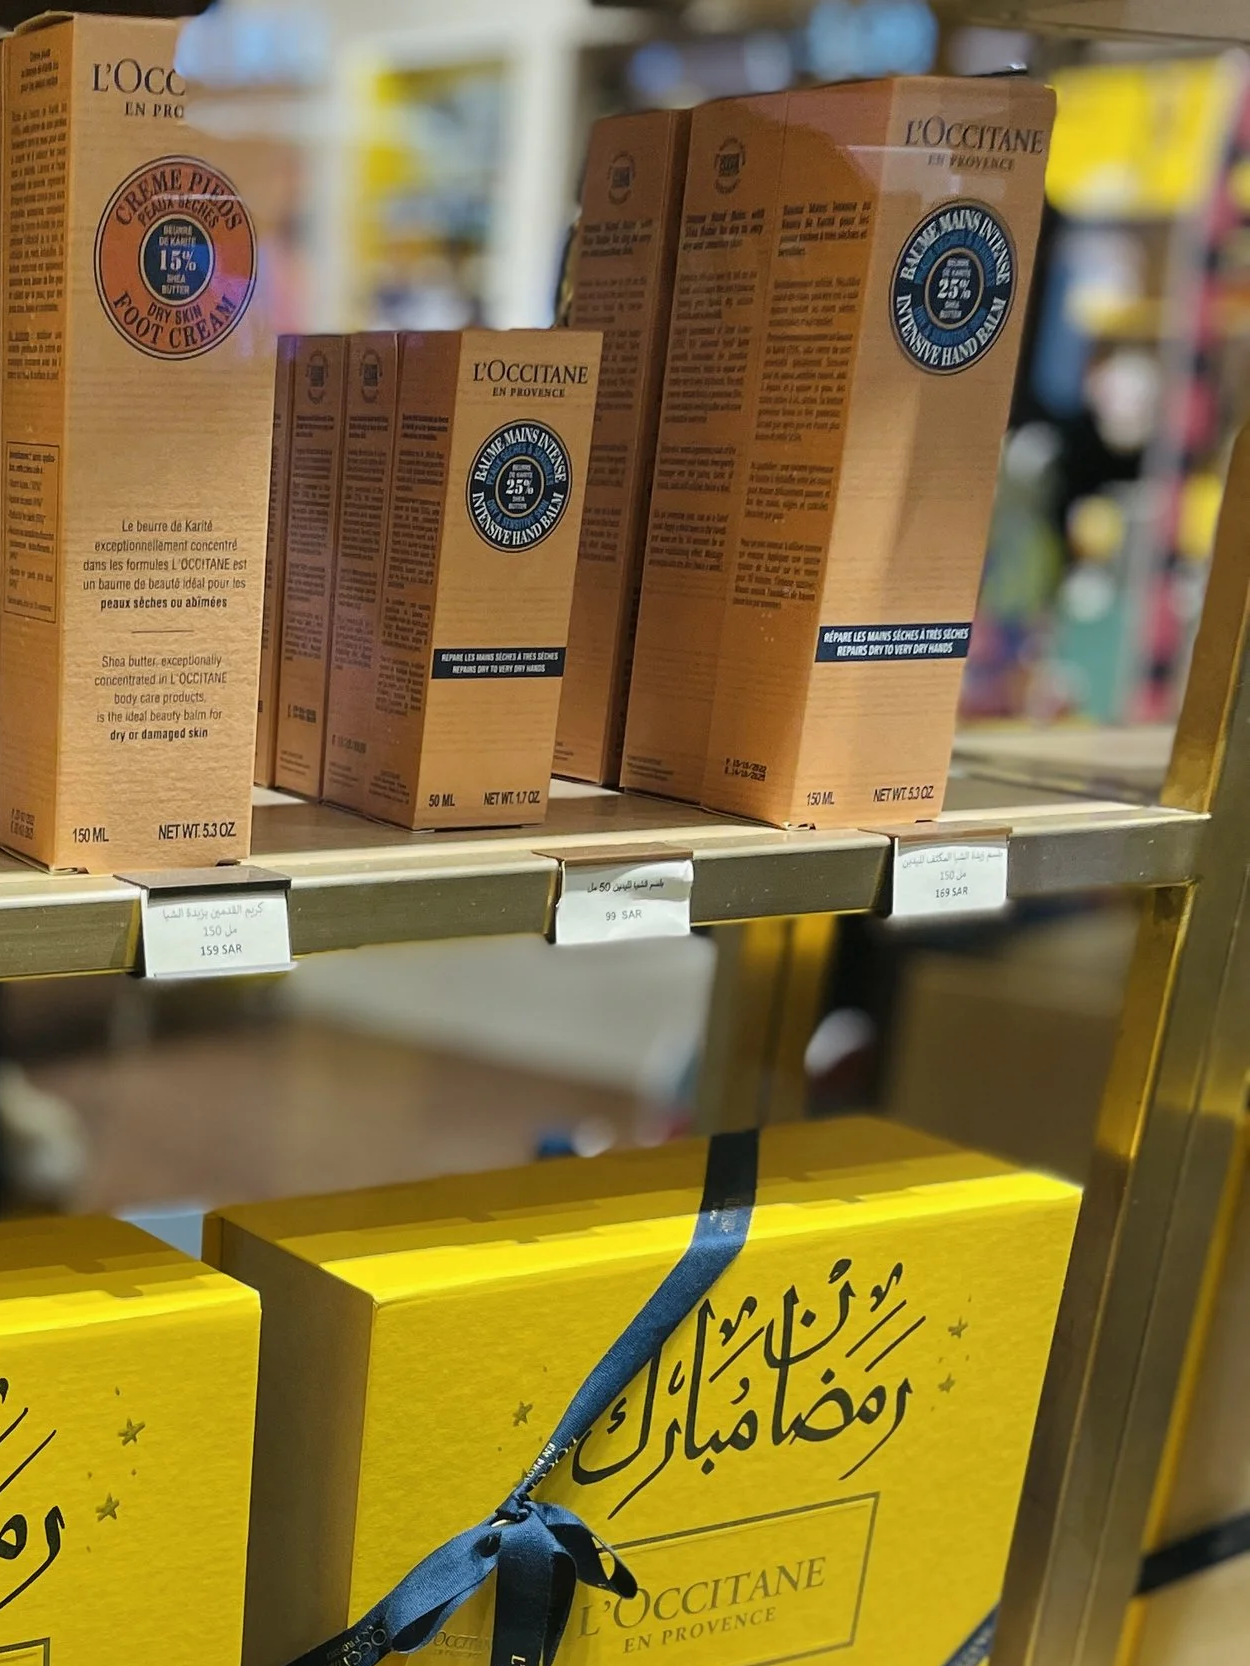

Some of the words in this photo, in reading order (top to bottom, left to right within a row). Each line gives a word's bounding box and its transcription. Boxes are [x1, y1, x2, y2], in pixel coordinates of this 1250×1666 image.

[905, 115, 1044, 154] L'OCCITANE
[191, 169, 242, 231] PIEDS
[160, 249, 196, 271] 15%
[937, 279, 971, 300] 25%
[113, 291, 163, 345] FOOT
[169, 295, 239, 349] CREAM
[148, 301, 171, 324] DRY
[176, 304, 200, 325] SKIN
[473, 360, 588, 384] L'OCCITANE
[493, 388, 506, 396] EN
[511, 388, 565, 398] PROVENCE
[475, 437, 505, 482] BAUME
[504, 427, 539, 444] MAINS
[537, 432, 566, 483] INTENSE
[506, 479, 534, 494] 25%
[122, 520, 133, 532] Le
[137, 520, 167, 532] beurre
[171, 521, 182, 532] de
[185, 520, 212, 532] Karité
[473, 492, 510, 545] INTENSIVE
[512, 524, 542, 545] HAND
[543, 493, 564, 528] BALM
[95, 539, 187, 553] exceptionnellement
[191, 539, 237, 551] concentré
[83, 560, 106, 571] dans
[110, 559, 123, 570] les
[127, 559, 168, 570] formules
[172, 558, 230, 570] L'OCCITANE
[233, 559, 247, 570] est
[83, 580, 95, 590] un
[99, 578, 131, 590] baume
[134, 578, 145, 589] de
[149, 578, 179, 589] beauté
[183, 578, 205, 589] idéal
[208, 580, 229, 592] pour
[233, 578, 246, 588] les
[101, 599, 130, 611] peaux
[171, 598, 182, 608] ou
[102, 656, 125, 667] Shea
[161, 654, 222, 667] exceptionally
[95, 675, 155, 686] concentrated
[159, 674, 167, 684] in
[171, 672, 227, 684] L'OCCITANE
[114, 693, 137, 705] body
[140, 693, 160, 703] care
[97, 712, 104, 722] is
[108, 711, 123, 721] the
[126, 711, 147, 721] ideal
[150, 710, 180, 723] beauty
[184, 709, 206, 720] balm
[210, 708, 222, 719] for
[111, 730, 125, 742] dry
[129, 731, 138, 740] or
[142, 728, 185, 741] damaged
[189, 728, 207, 737] skin
[429, 795, 440, 806] 50
[442, 794, 455, 806] ML
[483, 793, 499, 805] NET
[516, 792, 527, 803] 1.7
[807, 793, 821, 806] 150
[823, 793, 835, 804] ML
[873, 789, 890, 802] NET
[73, 828, 90, 842] 150
[93, 828, 109, 842] ML
[159, 825, 179, 839] NET
[182, 824, 199, 839] WT.
[203, 823, 218, 838] 5.3
[936, 888, 950, 898] 169
[952, 887, 968, 896] SAR
[606, 912, 616, 920] 99
[622, 910, 641, 919] SAR
[201, 946, 218, 956] 159
[222, 944, 242, 954] SAR
[578, 1556, 827, 1639] L'OCCITANE
[623, 1631, 650, 1654] EN
[662, 1606, 776, 1646] PROVENCE
